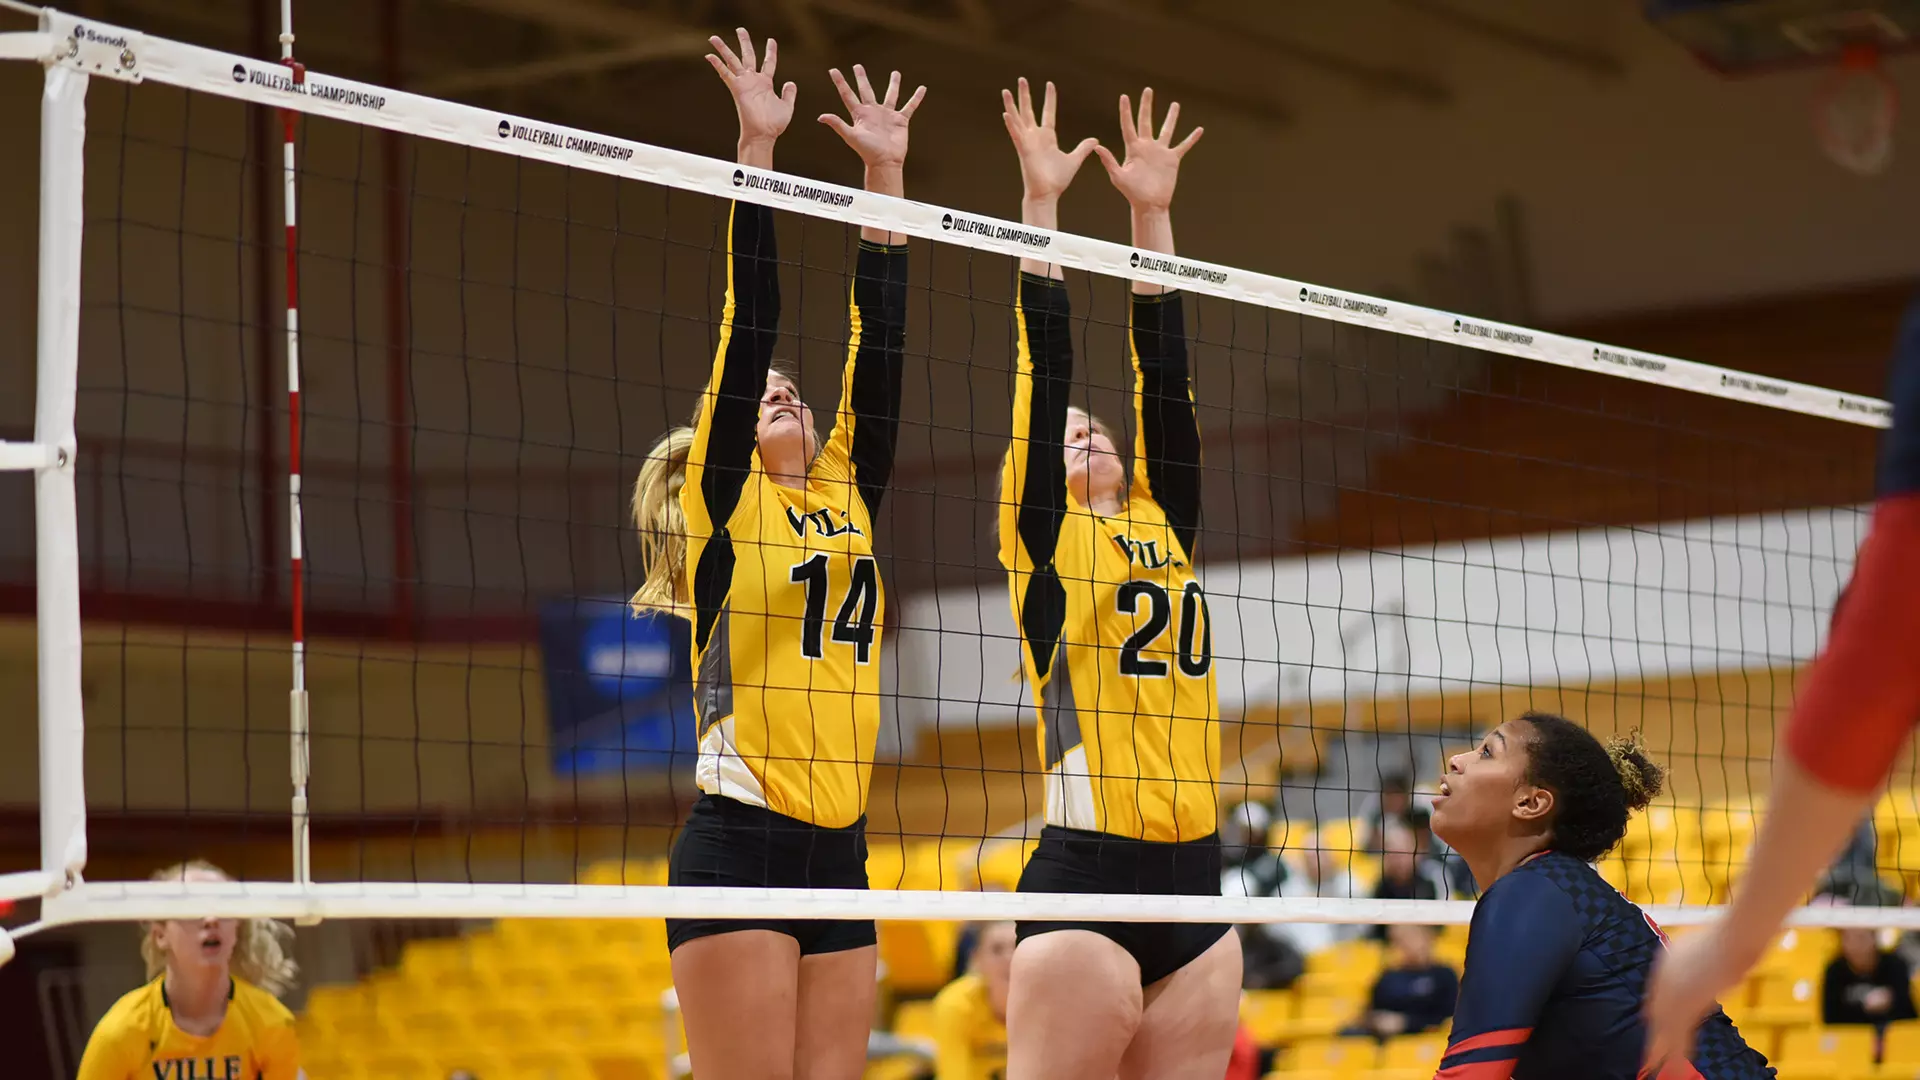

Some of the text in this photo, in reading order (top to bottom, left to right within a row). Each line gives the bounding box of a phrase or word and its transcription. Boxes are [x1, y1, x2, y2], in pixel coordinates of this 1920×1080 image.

[87, 29, 127, 48] Senoh
[310, 83, 386, 110] CHAMPIONSHIP
[512, 125, 634, 161] VOLLEYBALL CHAMPIONSHIP
[745, 174, 854, 208] VOLLEYBALL CHAMPIONSHIP
[953, 218, 1051, 248] VOLLEYBALL CHAMPIONSHIP
[1140, 256, 1228, 284] VOLLEYBALL CHAMPIONSHIP
[1308, 291, 1388, 317] VOLLEYBALL CHAMPIONSHIP
[785, 505, 865, 537] VIL
[1113, 534, 1184, 569] VIL
[789, 552, 879, 665] 14
[1116, 579, 1212, 678] 20
[152, 1055, 241, 1080] VILLE
